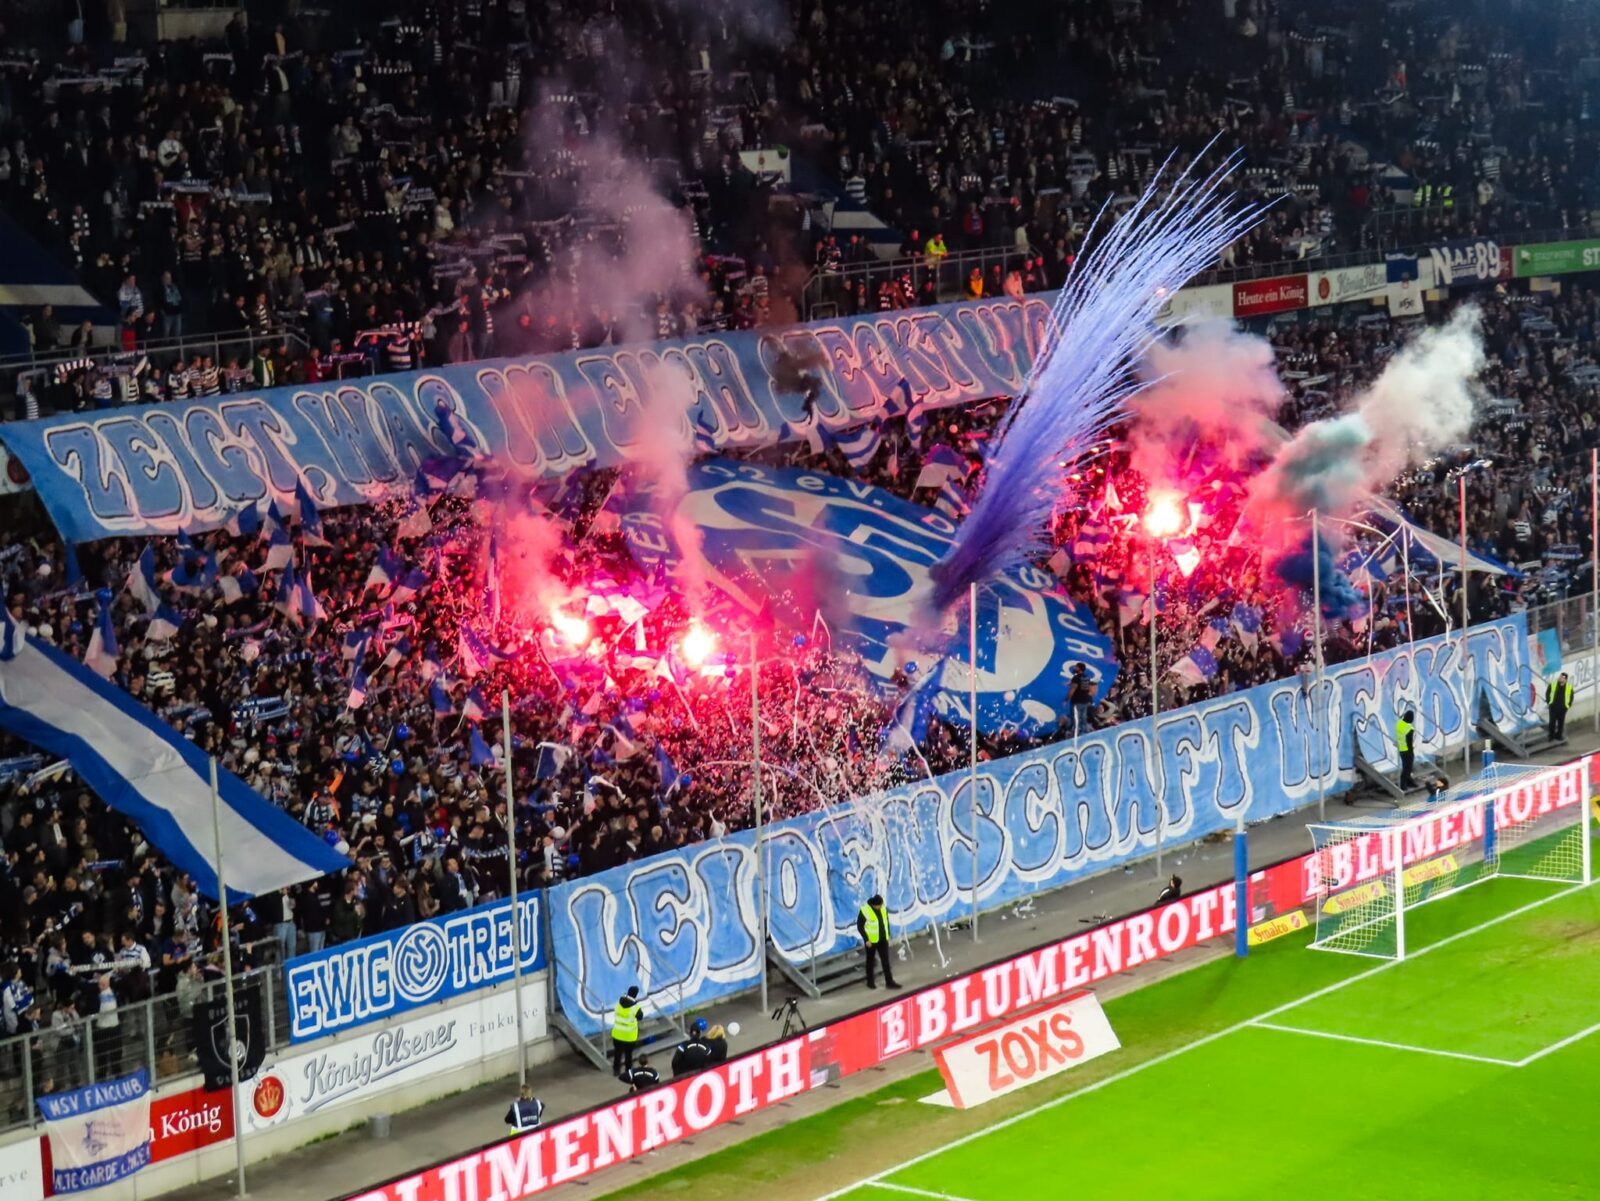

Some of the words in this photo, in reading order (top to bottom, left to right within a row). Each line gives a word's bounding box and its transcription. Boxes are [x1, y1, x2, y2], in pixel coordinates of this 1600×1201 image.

[1476, 241, 1501, 280] 89
[1238, 291, 1263, 307] Heute
[1265, 290, 1278, 303] ein
[1280, 285, 1305, 303] König
[568, 698, 1259, 1022] LEIDENSCHAFT
[1253, 921, 1289, 942] Sinalco
[288, 940, 395, 1037] EWIG
[445, 897, 539, 989] TREU
[915, 881, 1237, 1045] BLUMENROTH
[469, 1006, 539, 1038] Fankuve
[302, 1050, 372, 1101] König
[371, 1019, 458, 1074] Pilsener
[974, 1011, 1085, 1092] ZOXS
[49, 1094, 79, 1116] MSV
[84, 1077, 143, 1107] FANCLUB
[161, 1102, 221, 1140] König
[345, 1039, 805, 1201] LUMENROTH
[80, 1161, 118, 1186] GARDE
